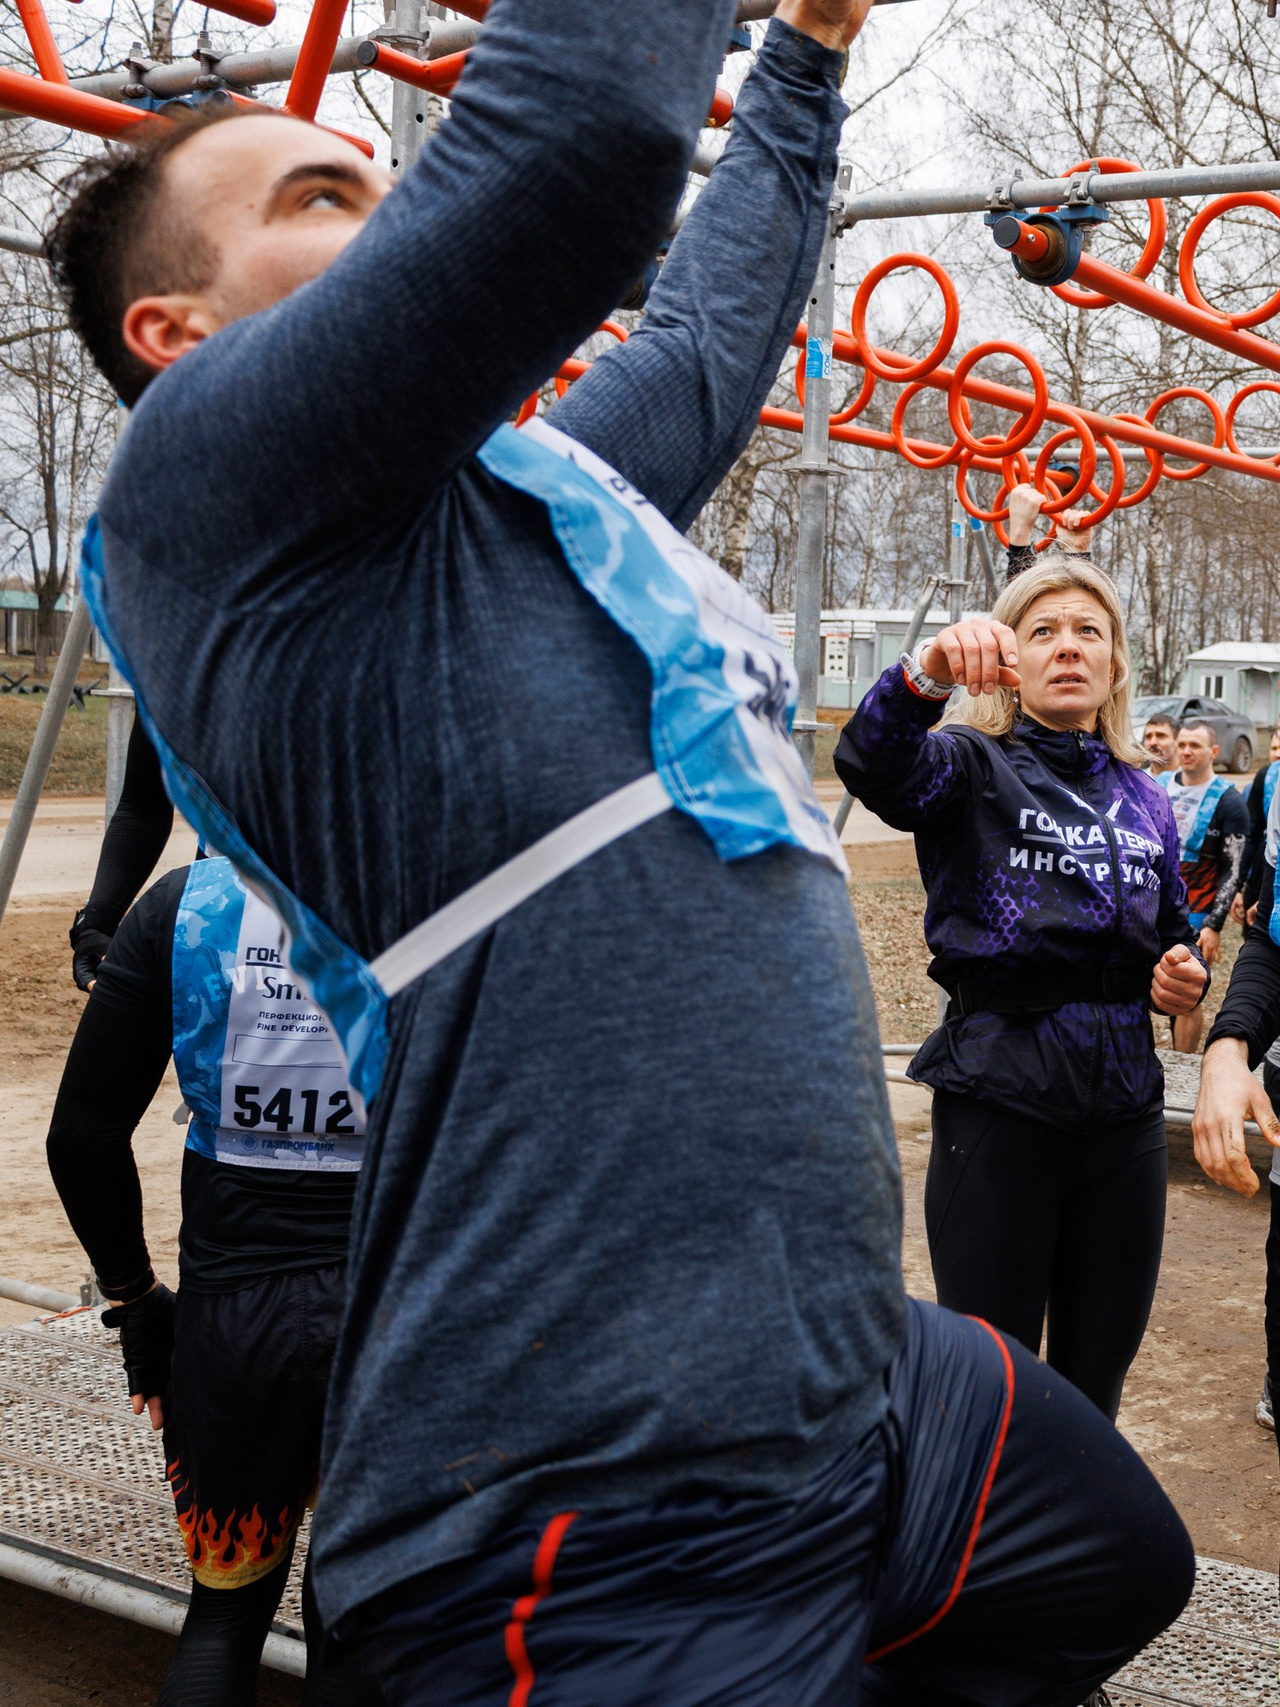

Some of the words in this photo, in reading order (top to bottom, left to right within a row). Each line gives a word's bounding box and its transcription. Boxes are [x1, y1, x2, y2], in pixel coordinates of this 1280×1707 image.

[1019, 808, 1107, 846] ГОНКА
[262, 976, 307, 999] Sm
[257, 1023, 277, 1031] FINE
[281, 1025, 328, 1033] DEVELOP
[233, 1085, 355, 1133] 5412
[262, 1140, 335, 1152] ГАЗПРОМБАНК
